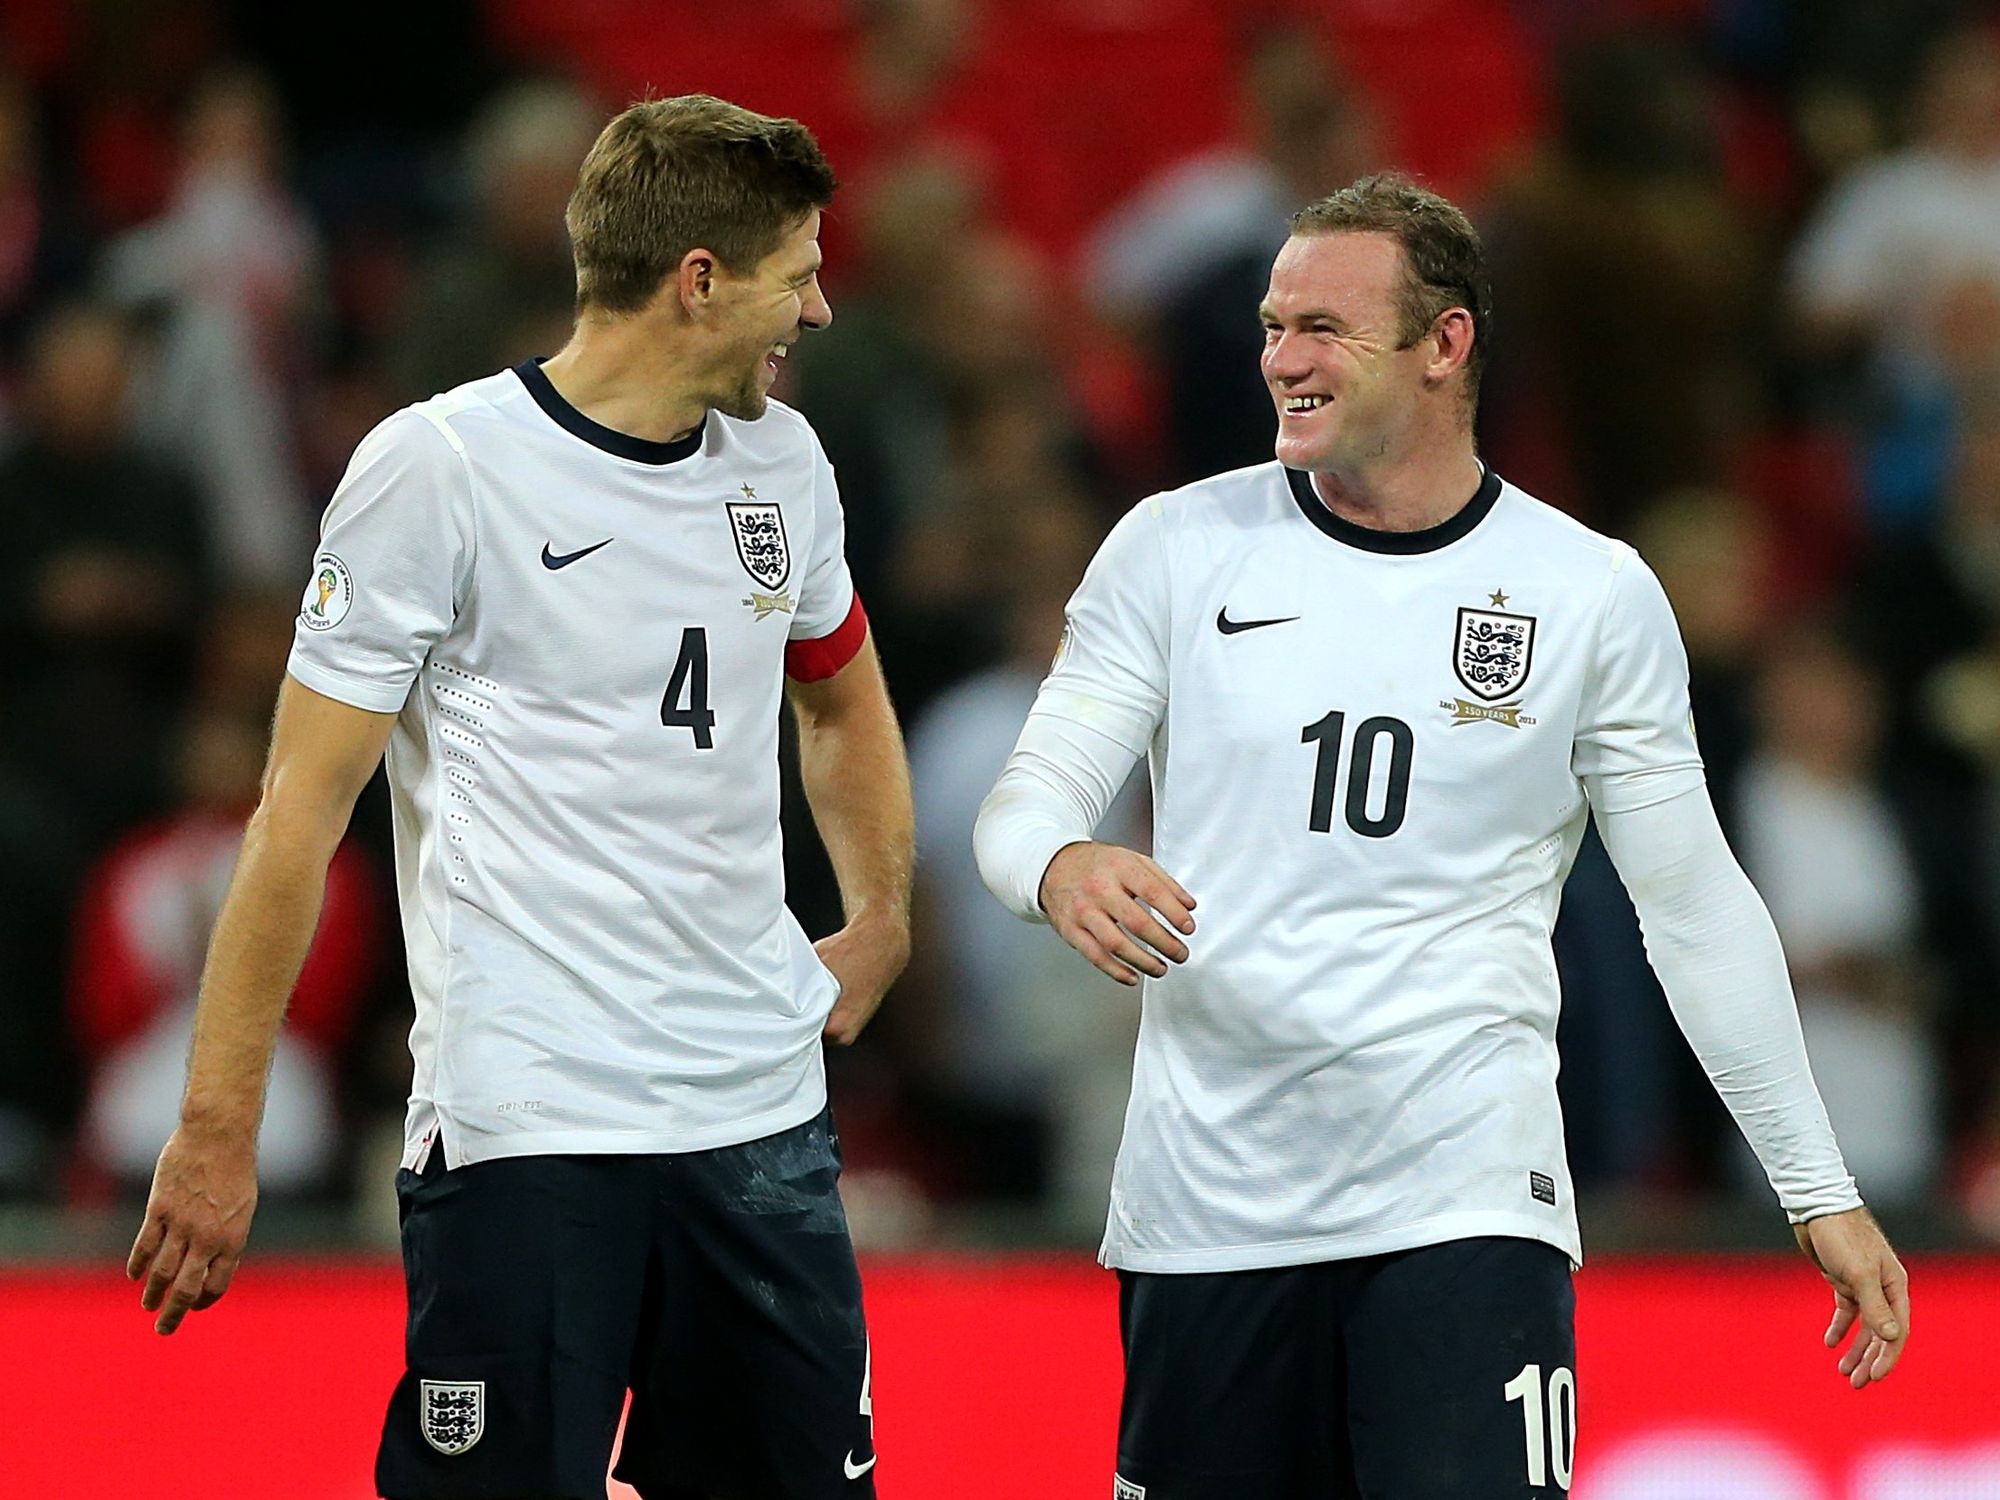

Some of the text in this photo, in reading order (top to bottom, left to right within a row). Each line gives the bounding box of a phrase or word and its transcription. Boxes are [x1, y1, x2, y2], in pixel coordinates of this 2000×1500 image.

[660, 627, 716, 749] 4
[1464, 706, 1509, 720] 150 YEARS
[1518, 715, 1537, 725] 2013
[1301, 710, 1414, 838] 10
[1504, 1364, 1577, 1491] 10
